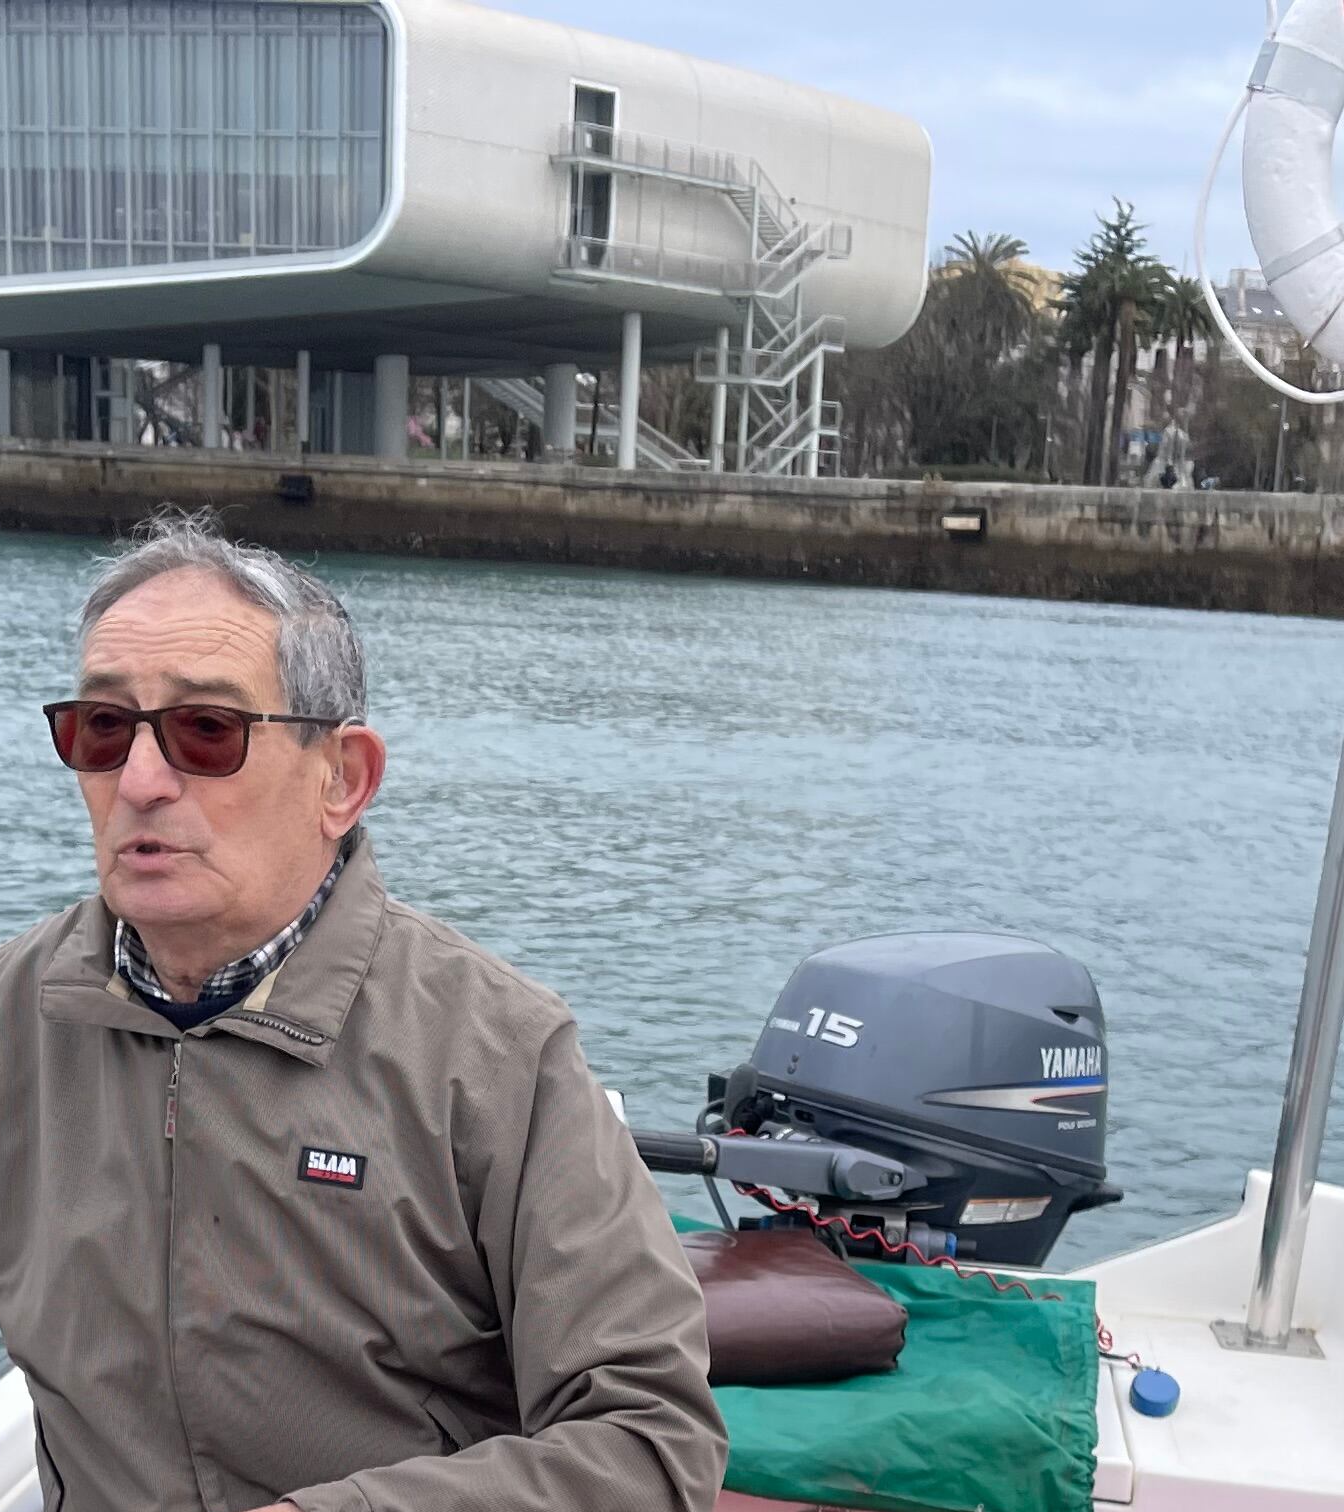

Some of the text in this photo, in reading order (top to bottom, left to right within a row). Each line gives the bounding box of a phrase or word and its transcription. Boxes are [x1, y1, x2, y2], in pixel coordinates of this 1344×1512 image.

[806, 1007, 865, 1048] 15
[1040, 1045, 1102, 1079] YAMAHA
[308, 1151, 356, 1176] SLAM
